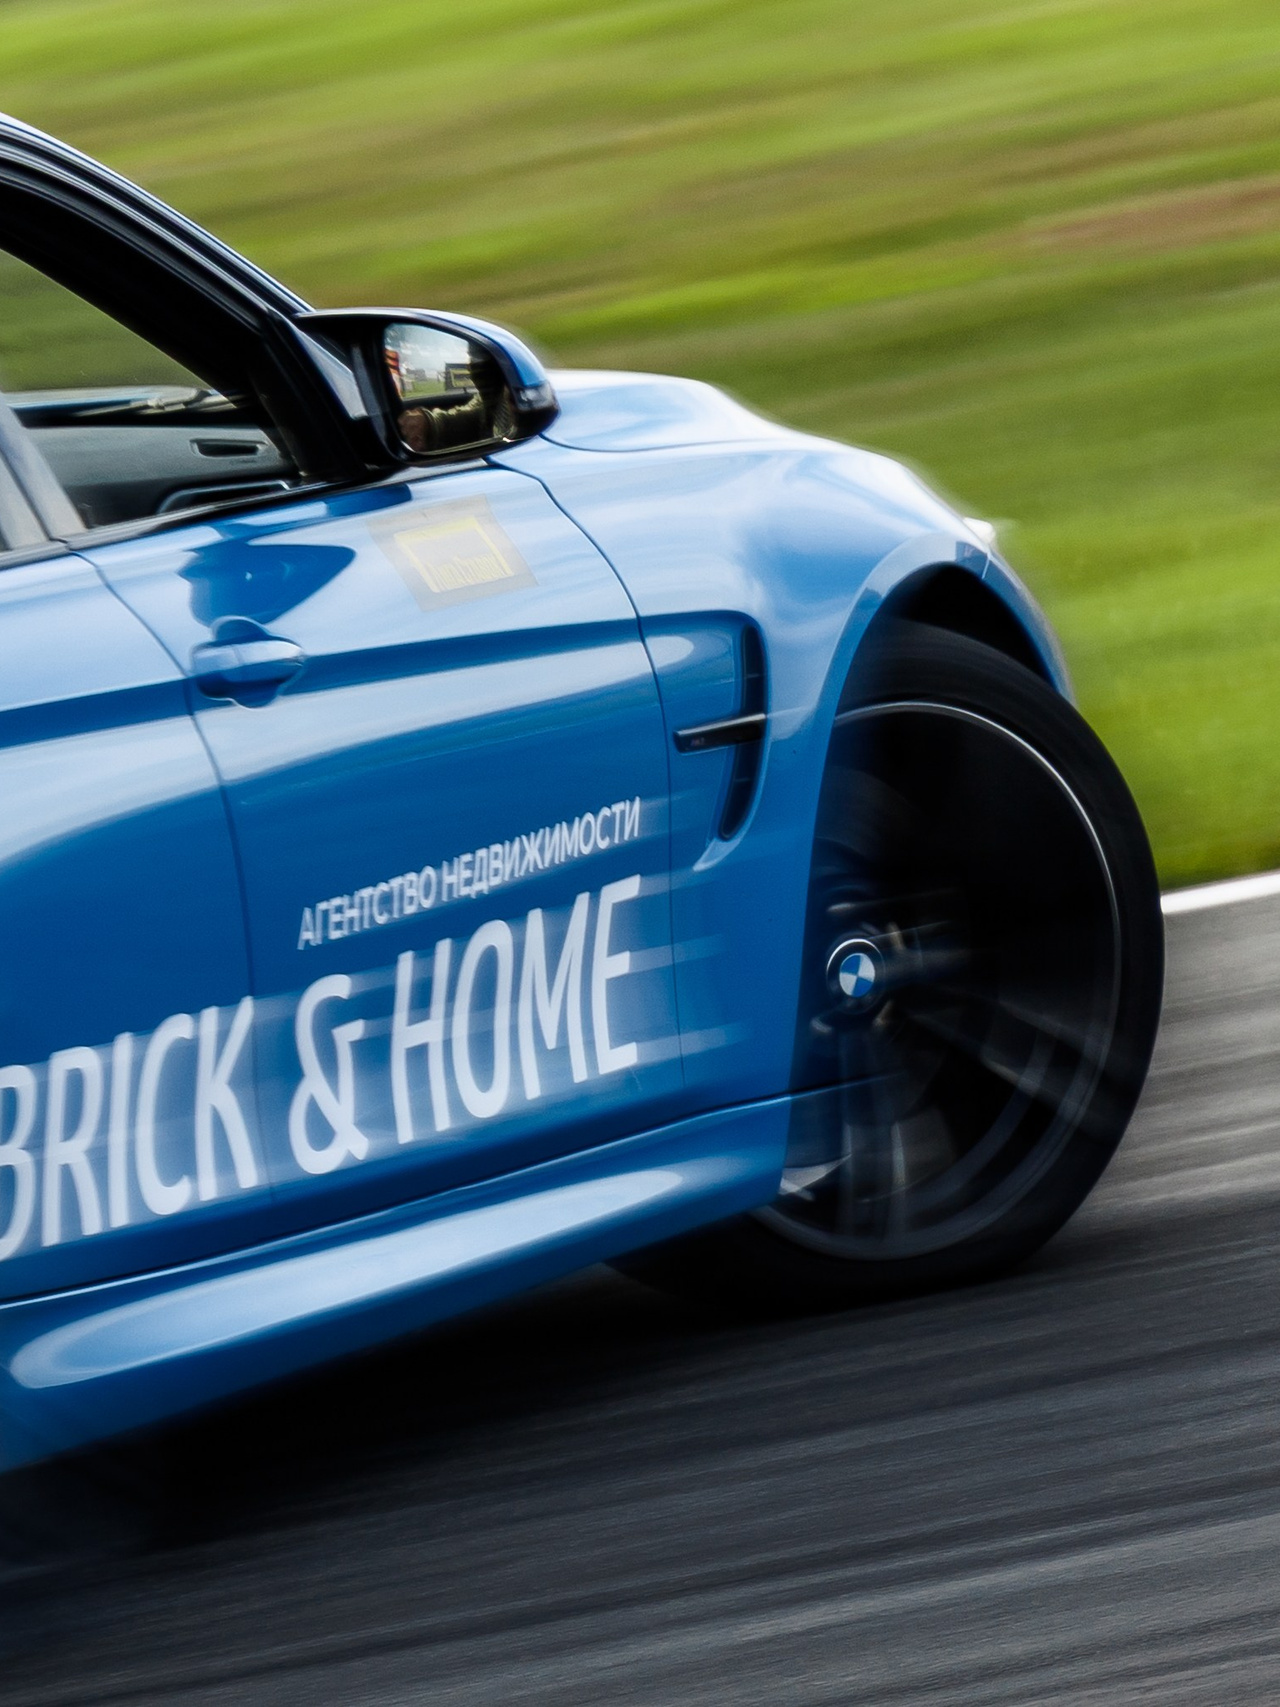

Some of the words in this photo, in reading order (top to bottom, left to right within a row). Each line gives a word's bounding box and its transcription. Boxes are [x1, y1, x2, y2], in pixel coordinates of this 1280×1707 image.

[297, 865, 437, 950] АГЕНТСТВО
[442, 796, 641, 902] НЕДВИЖИМОСТИ
[288, 974, 369, 1175] &
[391, 874, 642, 1144] HOME
